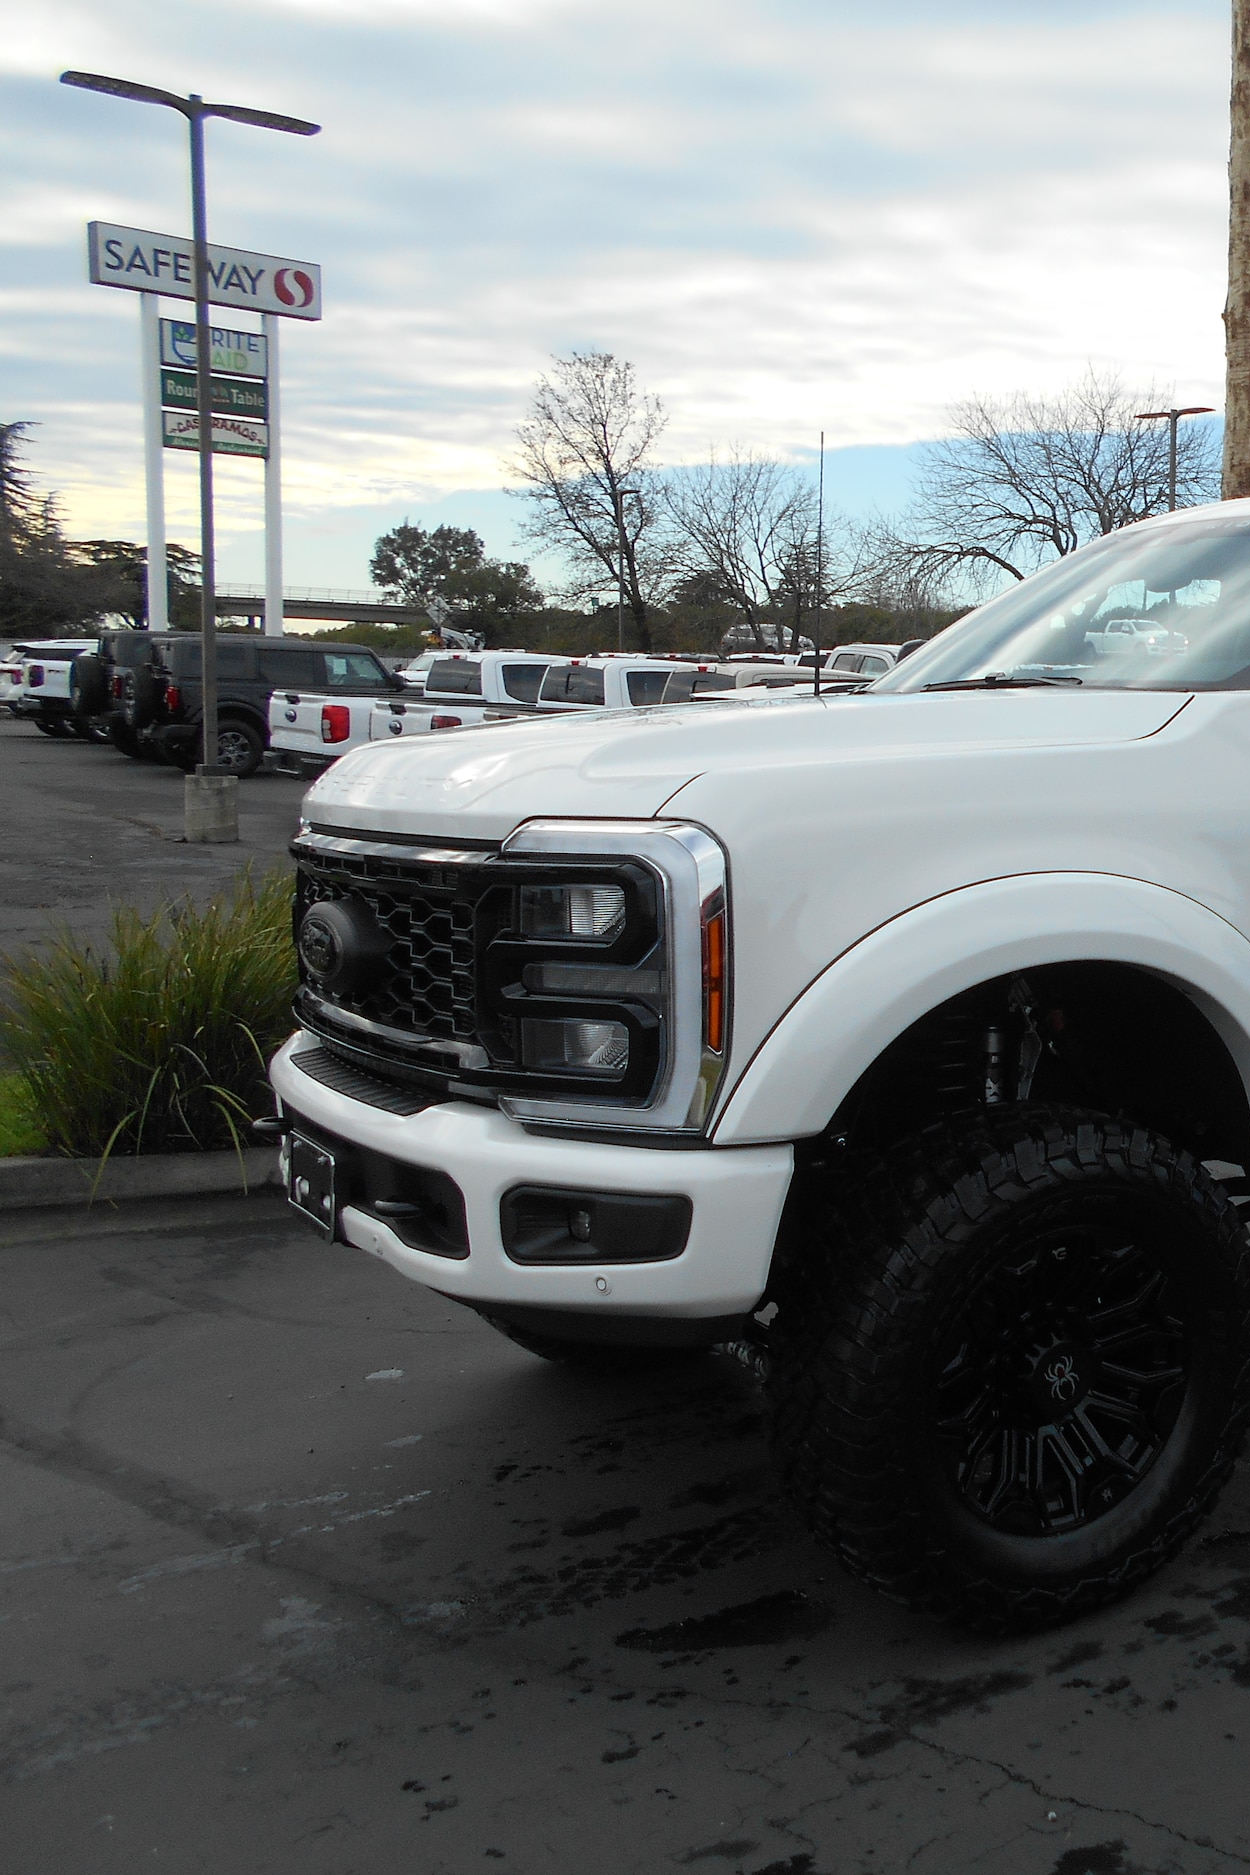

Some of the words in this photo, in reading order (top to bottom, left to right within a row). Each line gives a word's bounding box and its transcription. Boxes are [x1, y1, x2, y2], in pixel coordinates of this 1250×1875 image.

[211, 328, 260, 352] RITE
[211, 349, 248, 370] AID
[231, 388, 265, 407] Table
